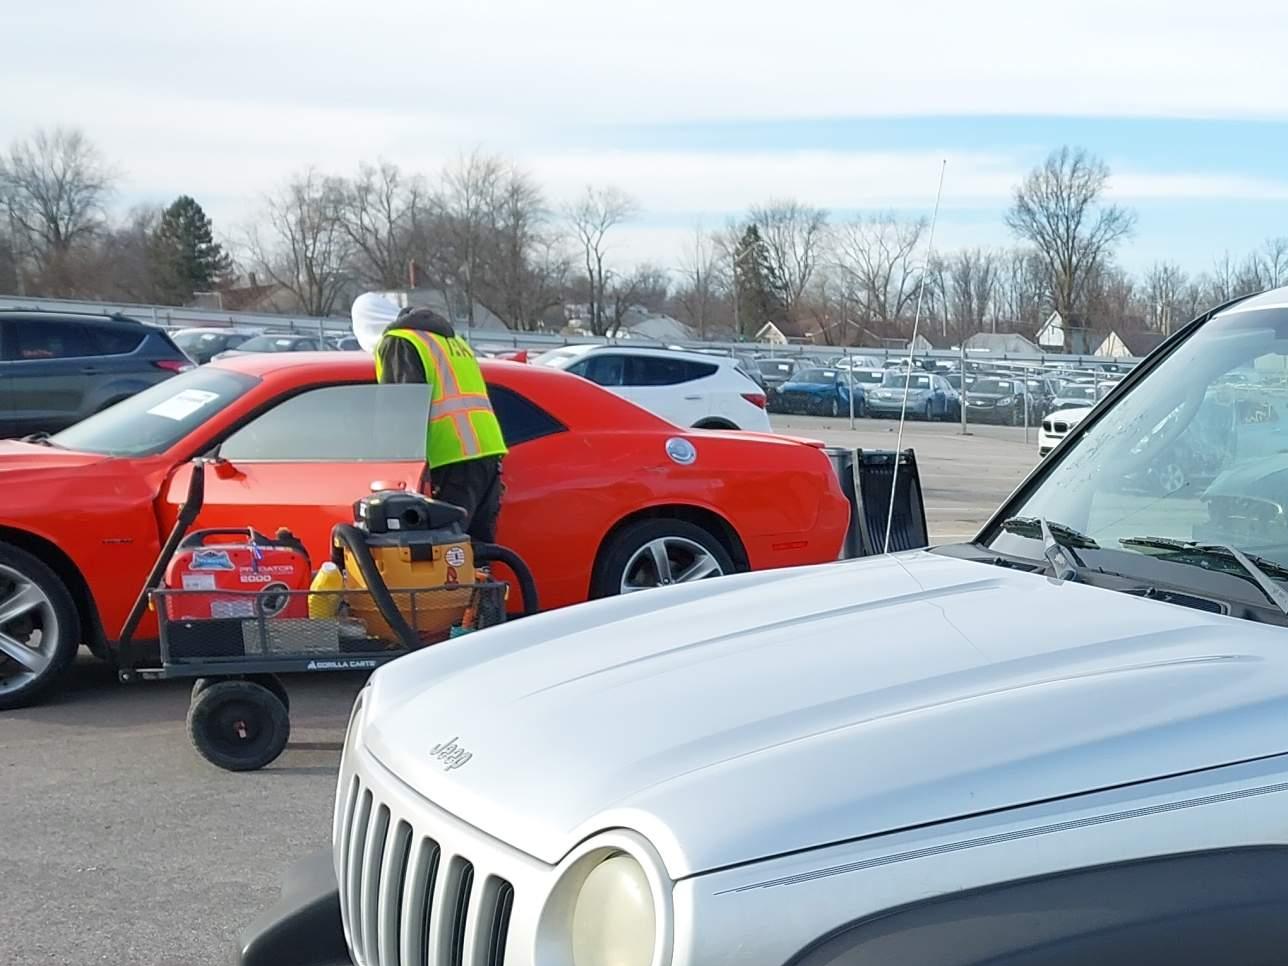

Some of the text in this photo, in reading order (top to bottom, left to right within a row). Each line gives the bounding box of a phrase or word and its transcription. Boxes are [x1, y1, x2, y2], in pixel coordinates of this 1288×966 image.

[240, 575, 272, 583] 2000
[316, 661, 349, 669] GORILLA
[429, 736, 473, 772] Jeep
